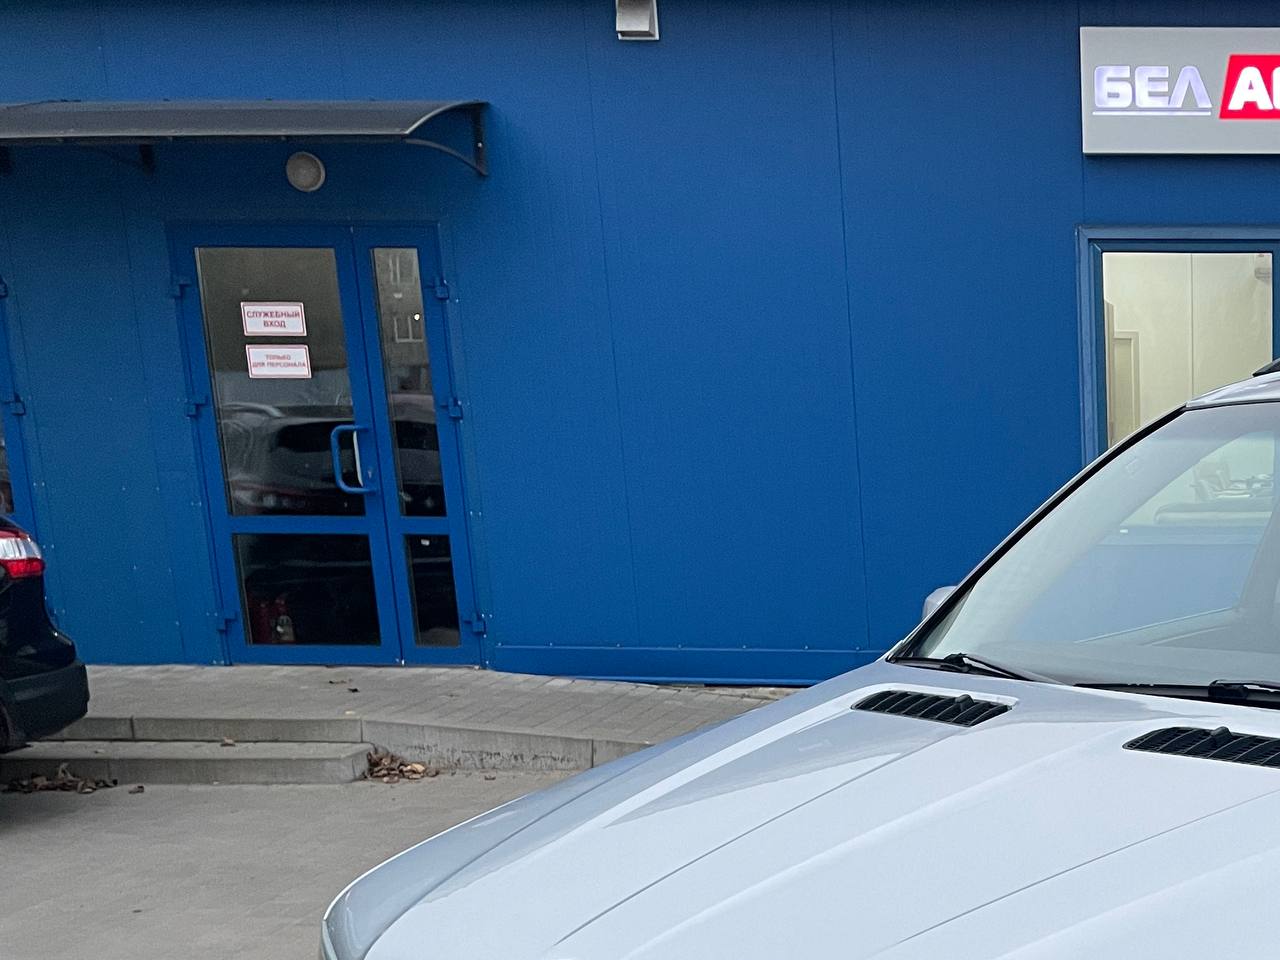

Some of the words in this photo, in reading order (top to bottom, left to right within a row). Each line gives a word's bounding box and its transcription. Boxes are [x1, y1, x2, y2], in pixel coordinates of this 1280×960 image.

[1094, 64, 1213, 109] БЕЛ
[246, 310, 300, 318] СЛУЖЕБНЫЙ
[263, 320, 287, 328] ВХОД
